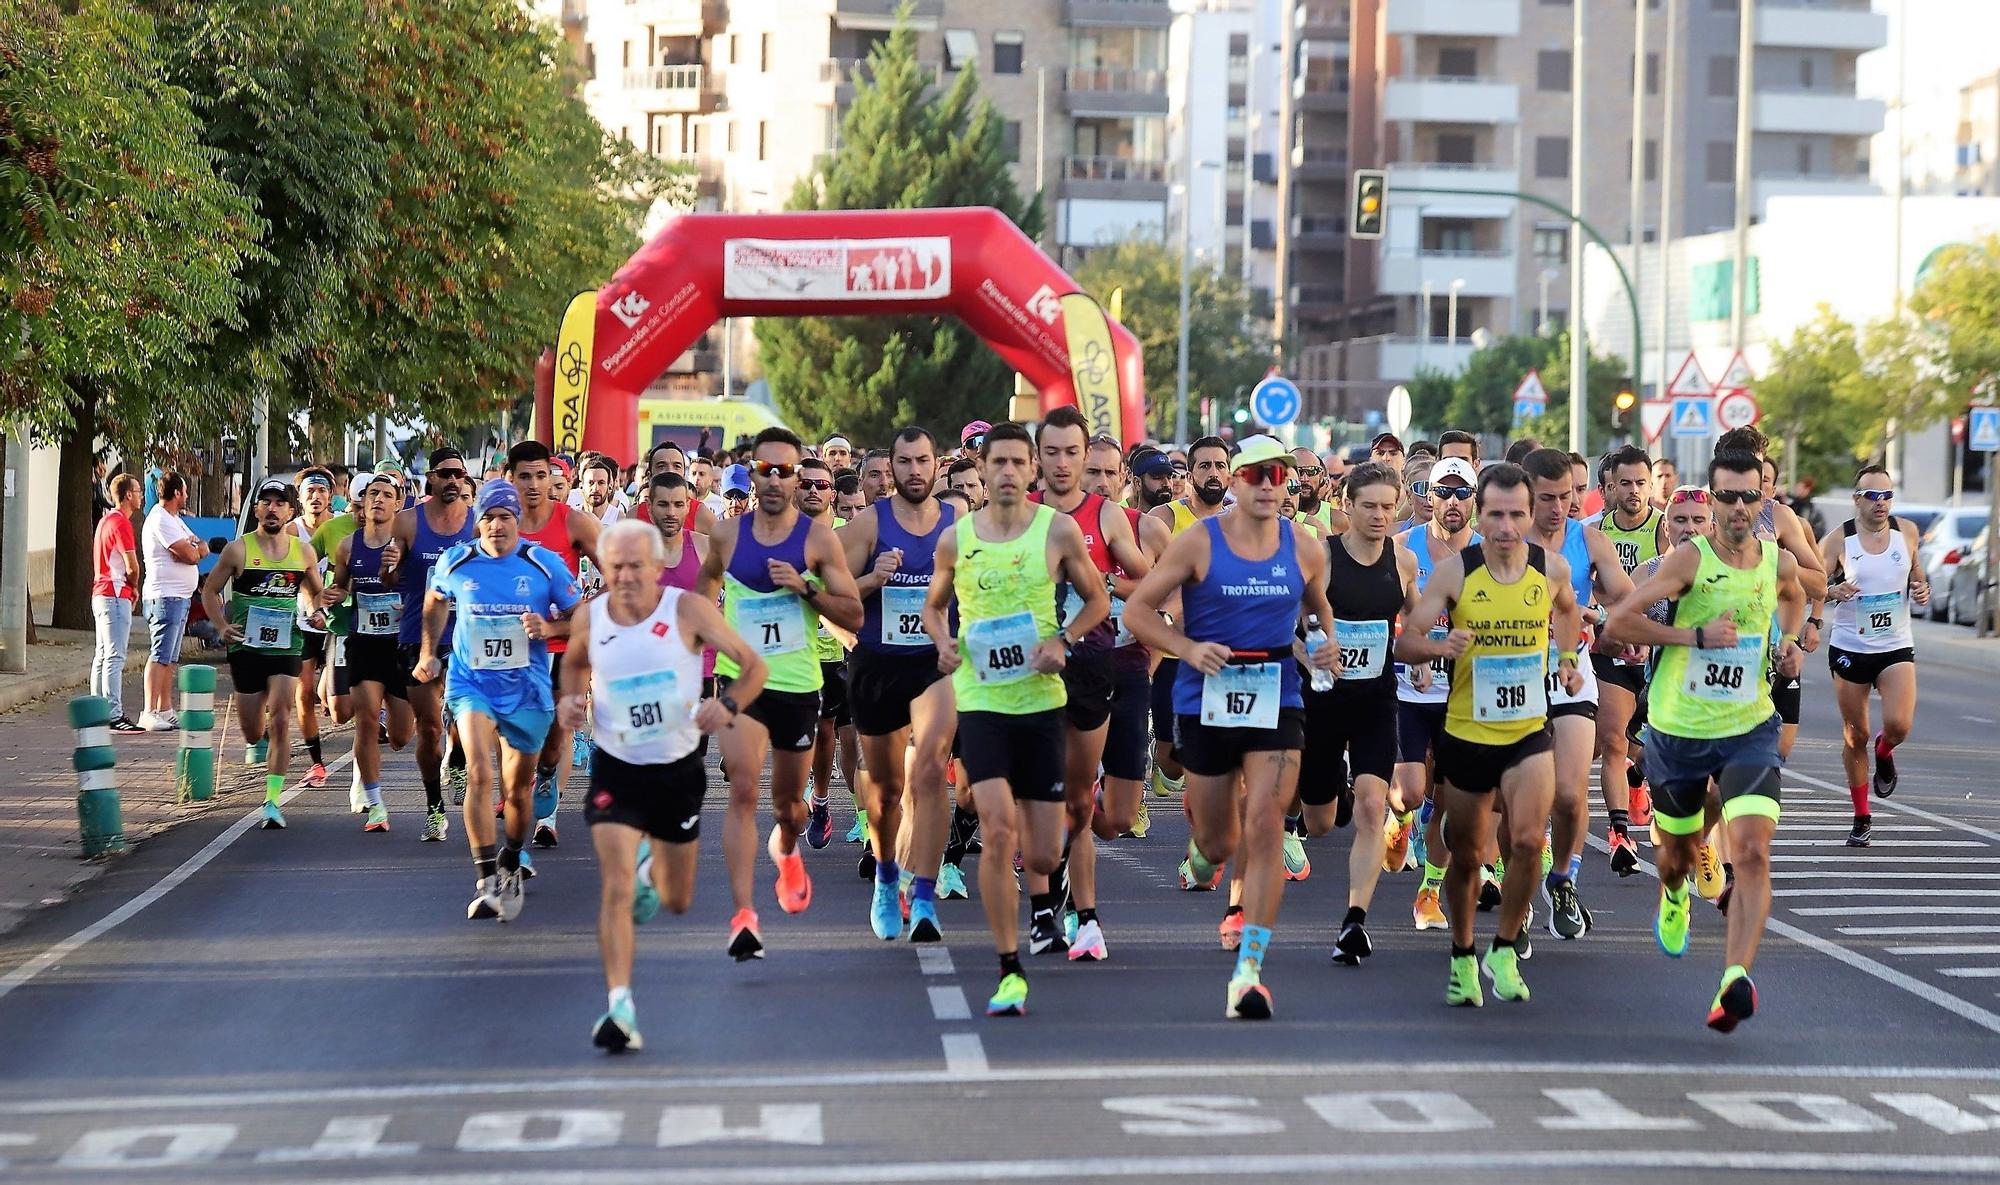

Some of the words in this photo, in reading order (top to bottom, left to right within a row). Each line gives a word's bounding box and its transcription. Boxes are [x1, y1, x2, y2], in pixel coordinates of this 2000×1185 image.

[601, 325, 649, 370] Diputación
[1221, 585, 1290, 596] TROTASIERRA
[465, 603, 532, 613] TROTASIERRA
[369, 612, 390, 627] 416
[1467, 620, 1490, 630] CLUB
[1870, 612, 1892, 629] 125
[761, 622, 781, 645] 71
[1474, 635, 1537, 647] MONTILLA
[484, 638, 513, 658] 579
[988, 645, 1025, 670] 488
[1339, 648, 1370, 669] 524
[1705, 663, 1744, 689] 348
[1226, 692, 1258, 715] 157
[1496, 684, 1526, 709] 319
[630, 700, 663, 728] 581
